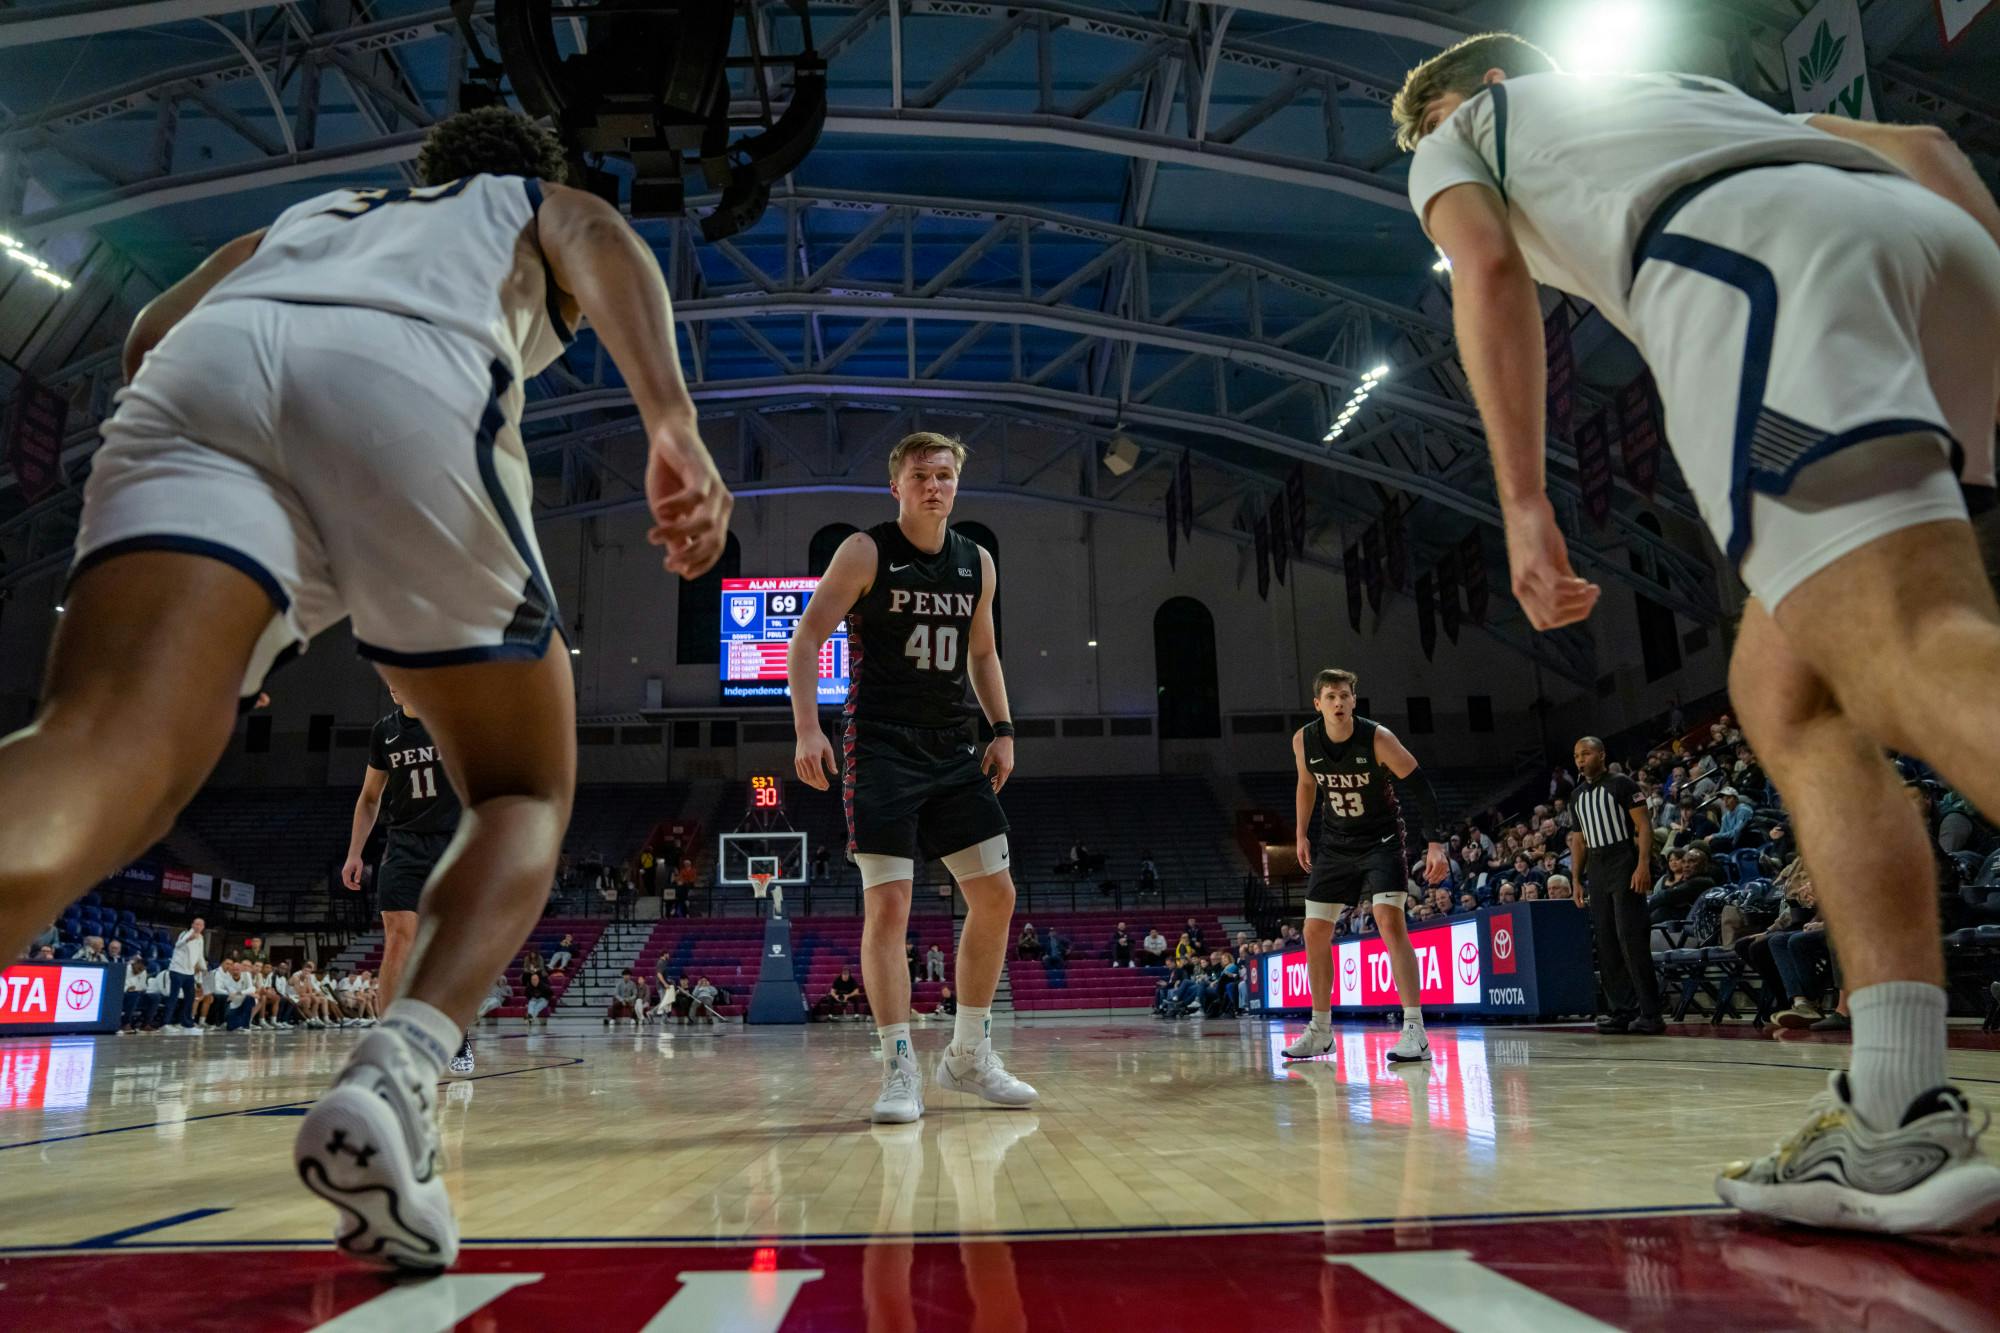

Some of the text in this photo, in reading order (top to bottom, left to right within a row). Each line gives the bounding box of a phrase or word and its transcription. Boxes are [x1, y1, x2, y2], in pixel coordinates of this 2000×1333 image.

[749, 580, 777, 590] ALAN
[771, 595, 797, 613] 69
[889, 589, 975, 617] PENN
[904, 624, 958, 671] 40
[724, 686, 783, 697] Independence
[388, 746, 442, 768] PEN
[410, 767, 437, 799] 11
[1314, 772, 1370, 788] PENN
[756, 788, 776, 806] 30
[1328, 791, 1365, 817] 23
[1368, 946, 1442, 993] TOTA
[1488, 987, 1525, 1005] TOYOTA
